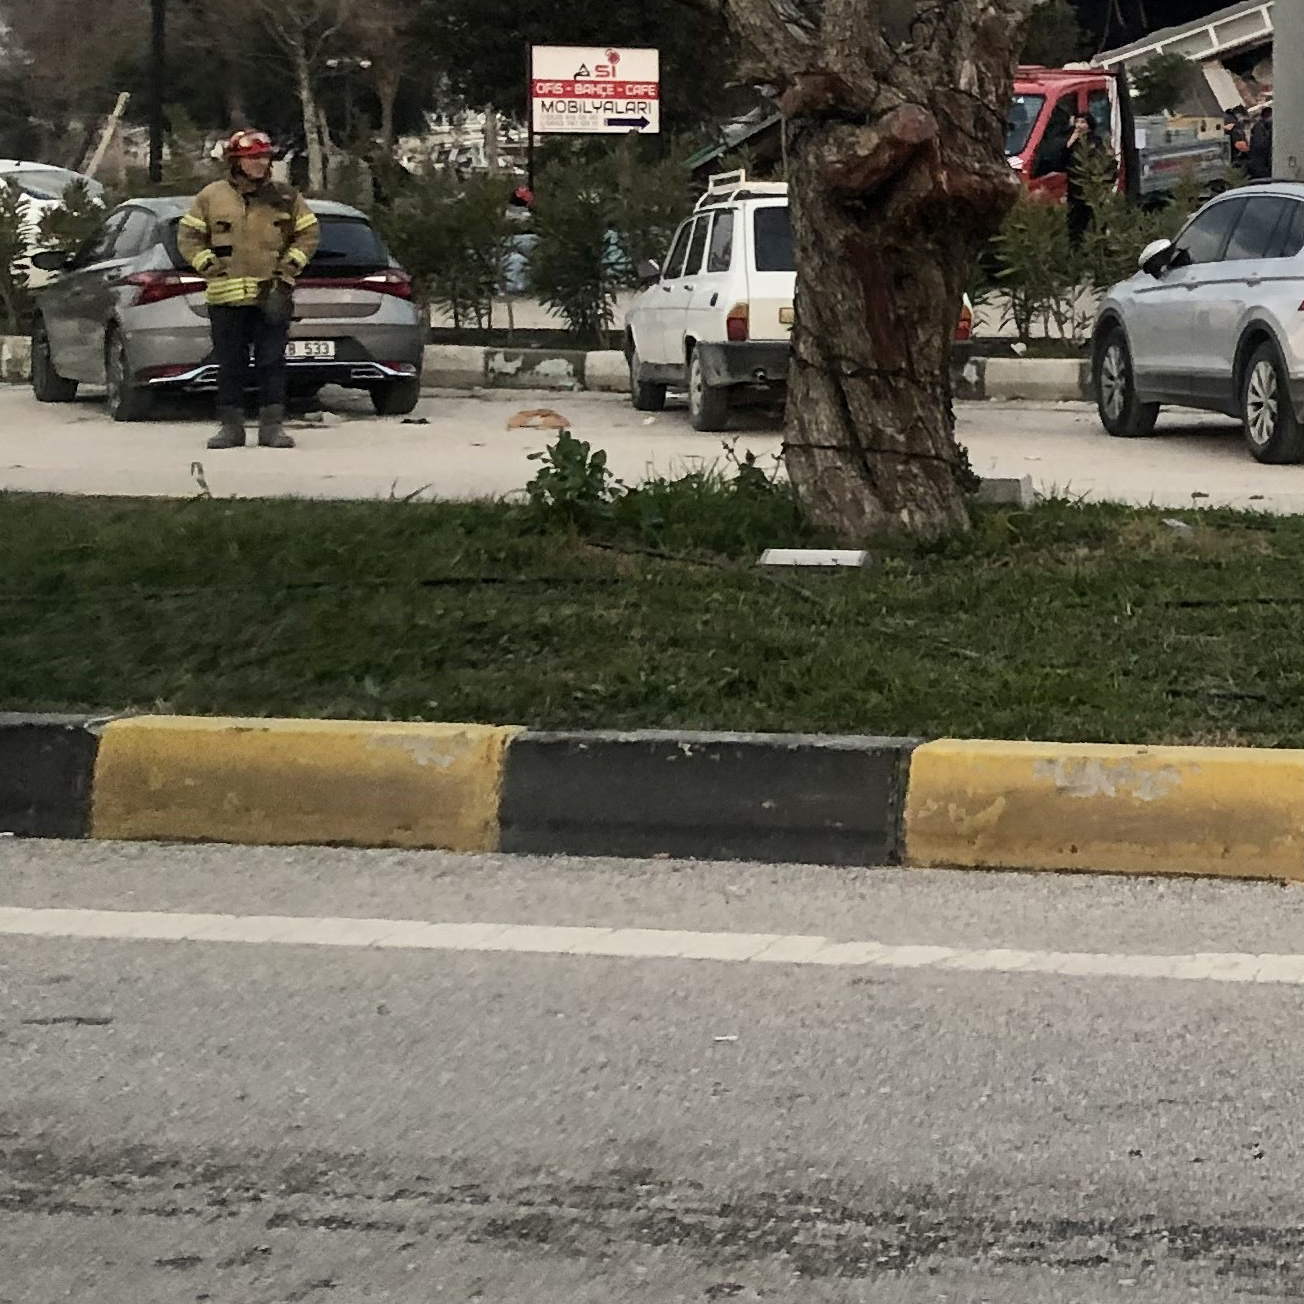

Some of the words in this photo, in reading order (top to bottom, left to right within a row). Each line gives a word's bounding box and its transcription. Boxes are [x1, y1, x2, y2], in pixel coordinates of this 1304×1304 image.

[574, 83, 615, 98] BAHÇE
[625, 84, 657, 97] CAFE
[304, 342, 330, 356] 533
